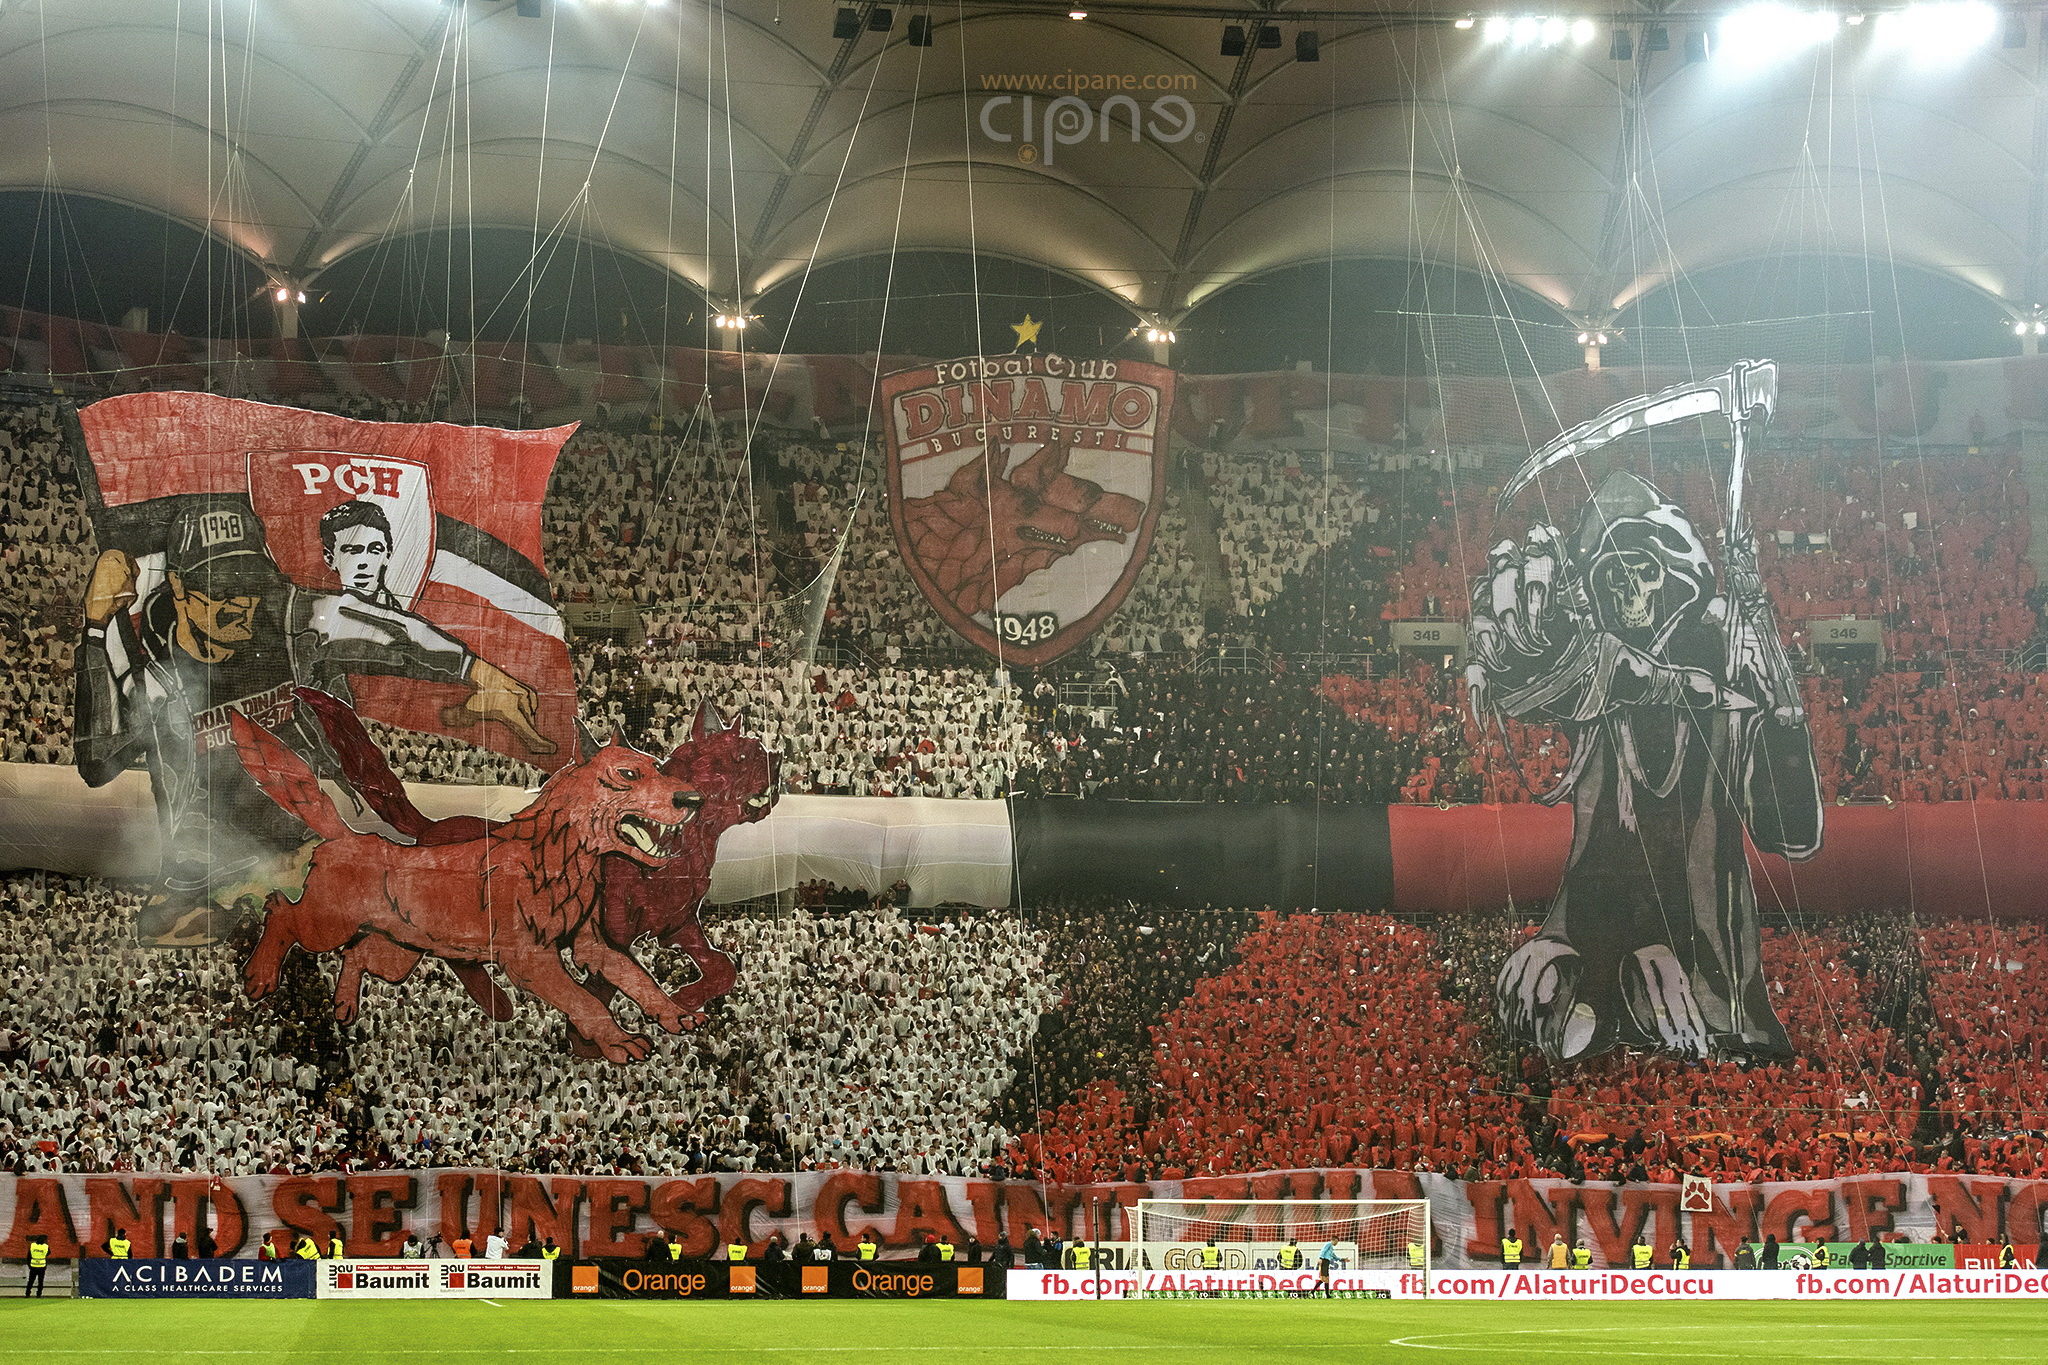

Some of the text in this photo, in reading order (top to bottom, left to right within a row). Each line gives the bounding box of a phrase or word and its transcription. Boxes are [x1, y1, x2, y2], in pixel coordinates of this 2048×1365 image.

[934, 354, 1117, 384] Fotbal Club
[901, 377, 1154, 440] DINAMO
[931, 425, 1122, 453] BUCURESTI
[292, 463, 403, 499] PCH
[203, 515, 241, 543] 1948
[994, 615, 1056, 641] 1948
[1413, 630, 1440, 641] 348
[1830, 628, 1857, 639] 346
[271, 1174, 418, 1260] SE
[437, 1173, 794, 1261] UNESC
[1164, 1249, 1247, 1270] GOD
[1886, 1252, 1947, 1269] Sportive
[112, 1265, 283, 1283] ACIBADEM
[355, 1273, 430, 1289] Baumit
[467, 1273, 540, 1289] Baumit
[623, 1269, 706, 1296] Orange
[852, 1269, 934, 1296] Orange
[573, 1284, 597, 1292] orange
[730, 1284, 755, 1292] orange
[802, 1284, 827, 1292] orange
[958, 1285, 983, 1293] orange
[1399, 1273, 1714, 1298] fb.com/AlaturiDeCucu
